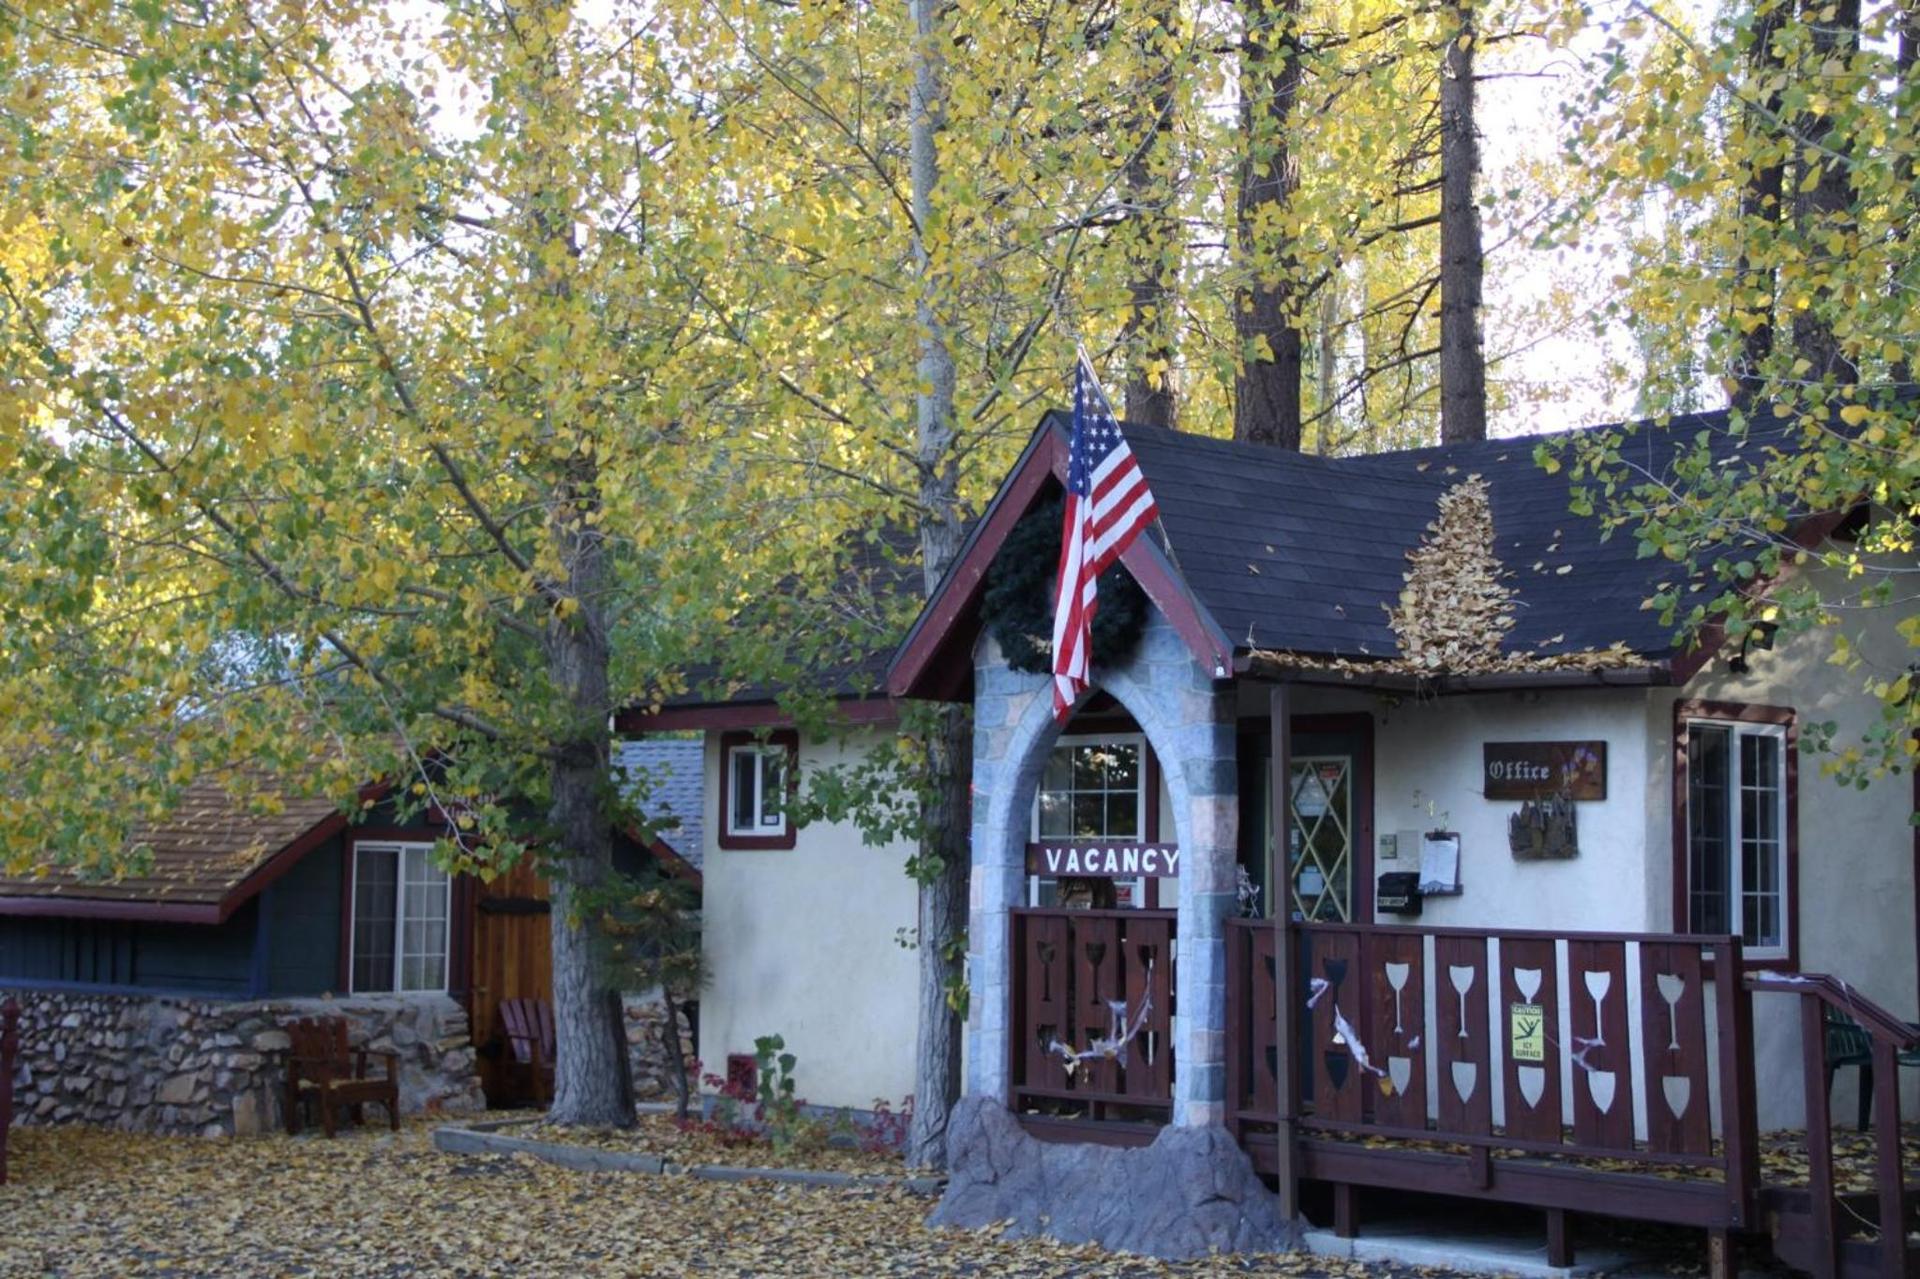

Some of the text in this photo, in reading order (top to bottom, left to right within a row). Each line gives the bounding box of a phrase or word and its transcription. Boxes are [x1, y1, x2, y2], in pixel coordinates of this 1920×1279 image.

[1488, 761, 1550, 779] Office
[1046, 848, 1180, 874] VACANCY
[1513, 1005, 1541, 1014] CAUTION
[1515, 1050, 1541, 1058] SURFACE
